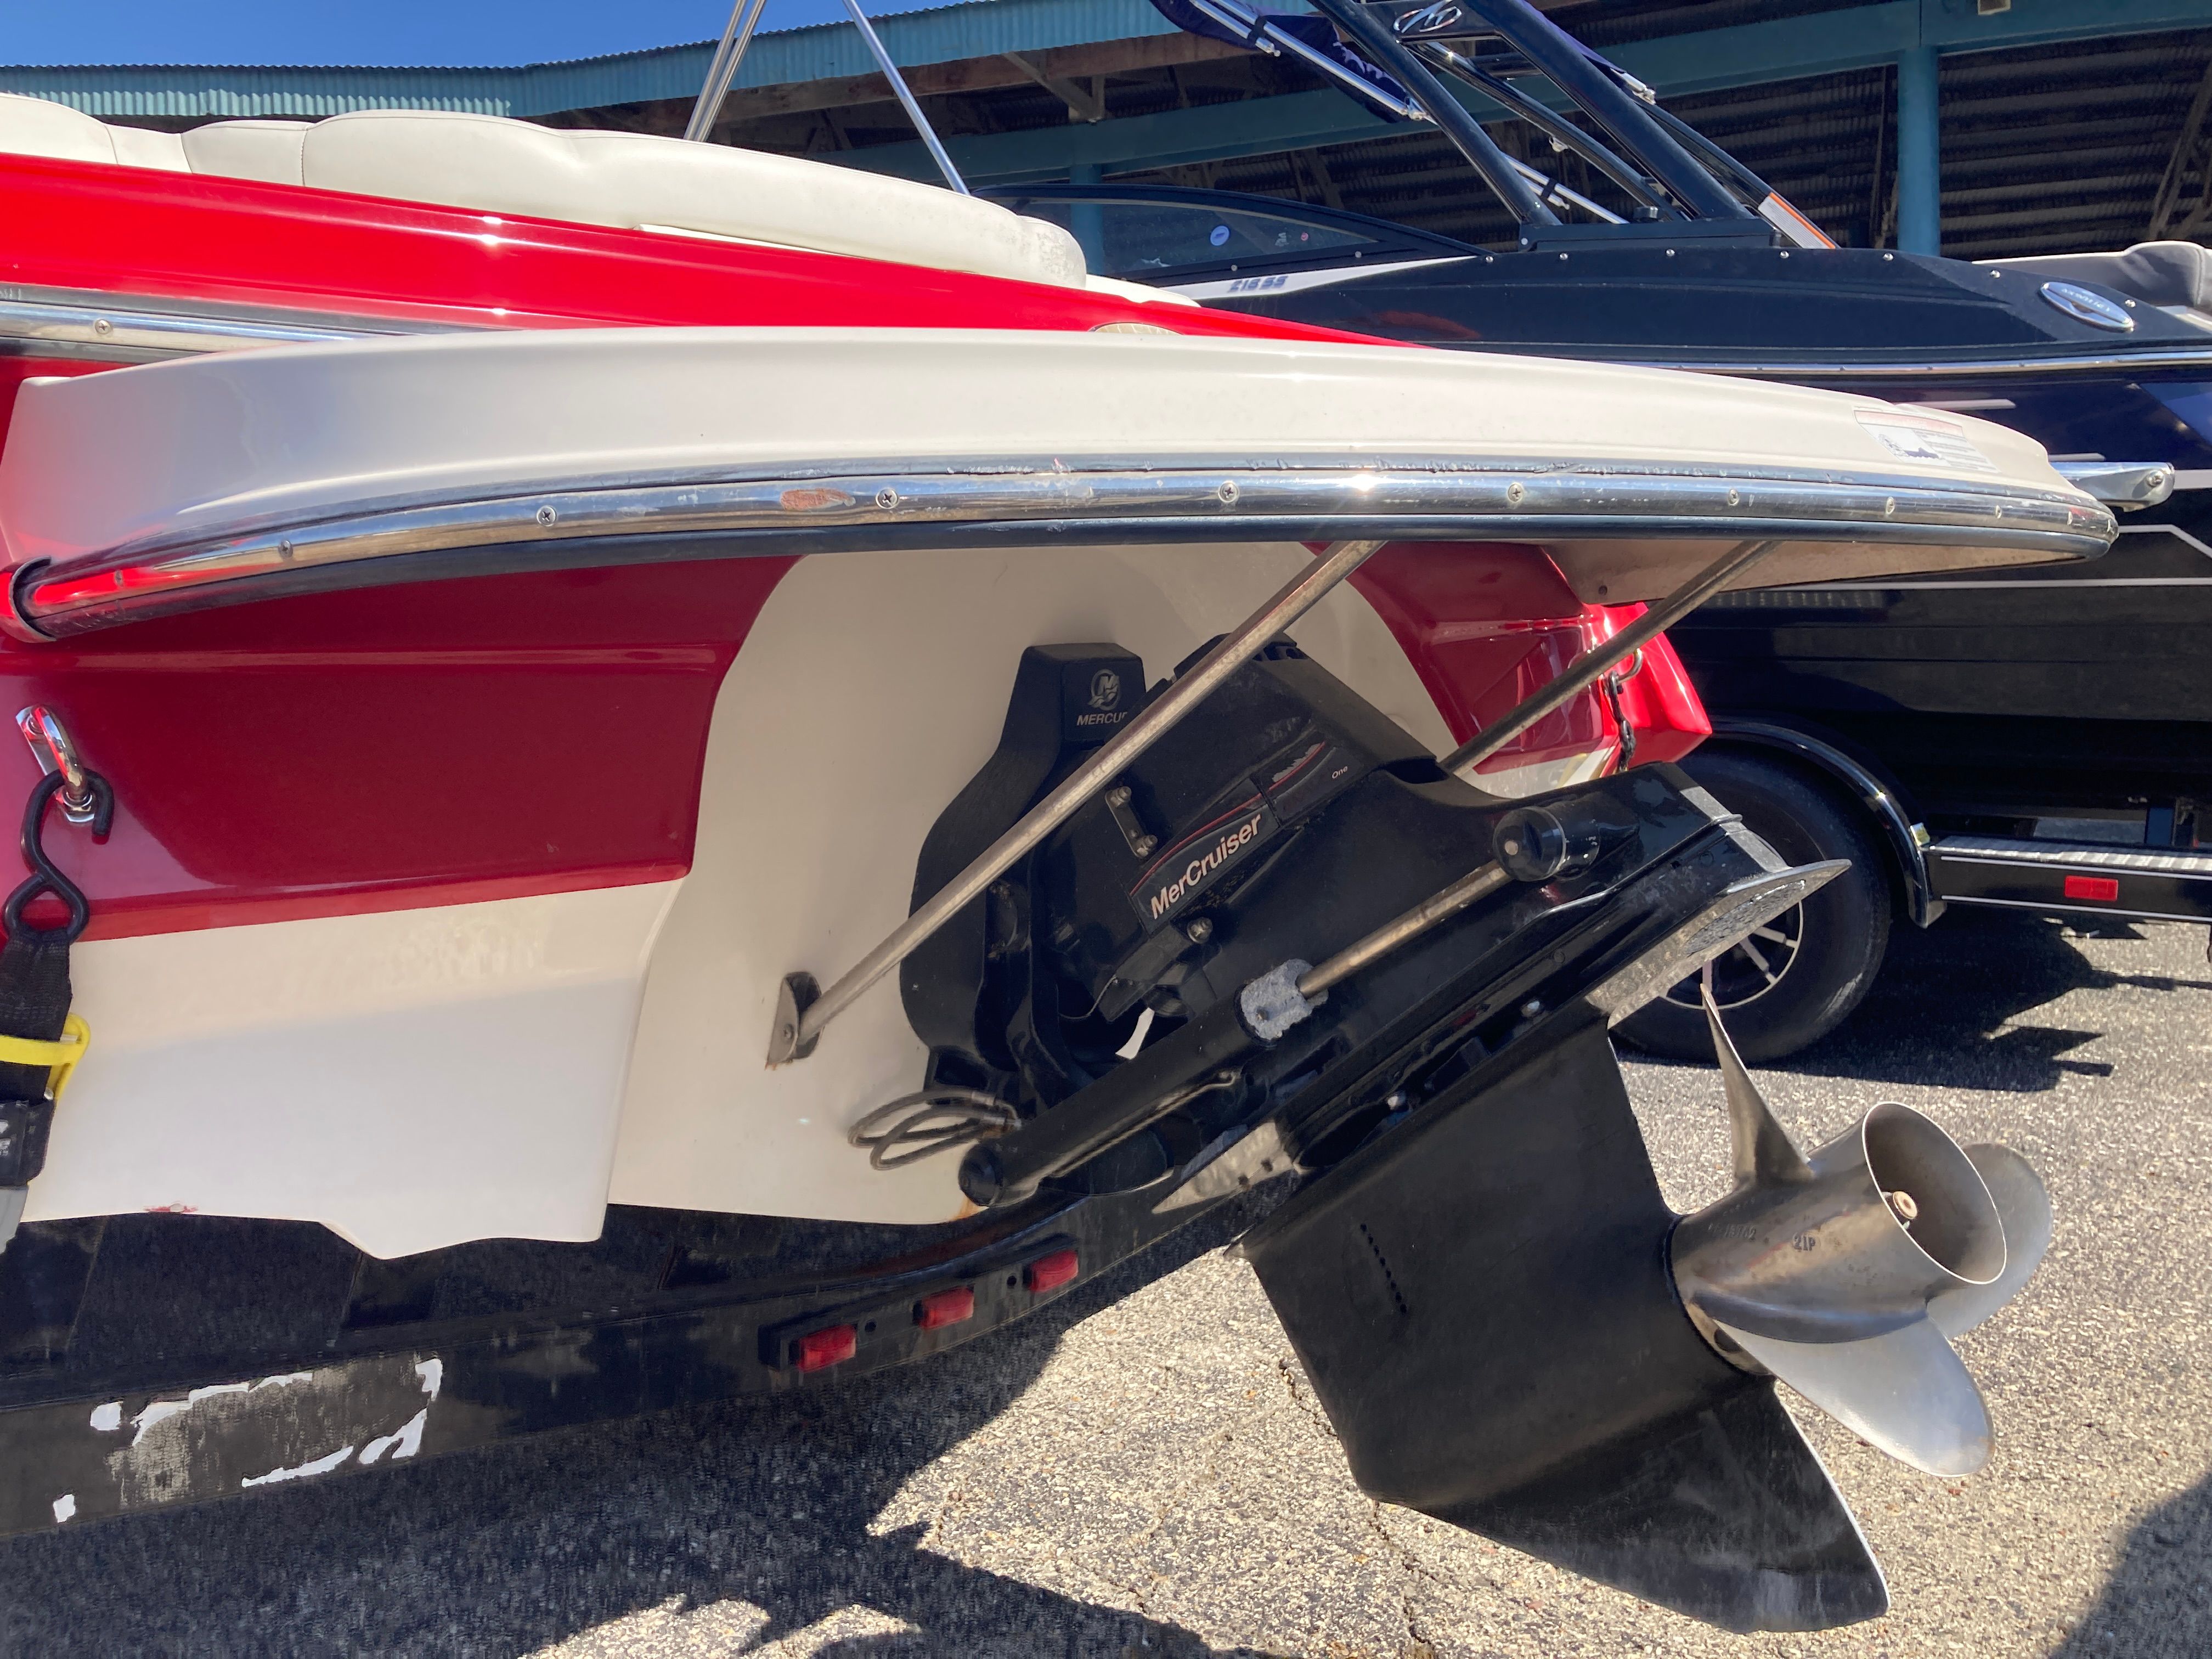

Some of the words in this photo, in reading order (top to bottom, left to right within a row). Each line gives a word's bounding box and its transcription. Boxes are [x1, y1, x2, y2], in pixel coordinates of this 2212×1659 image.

[1331, 766, 1348, 779] One
[1151, 814, 1261, 919] MerCruiser
[1793, 1234, 1816, 1251] 21P
